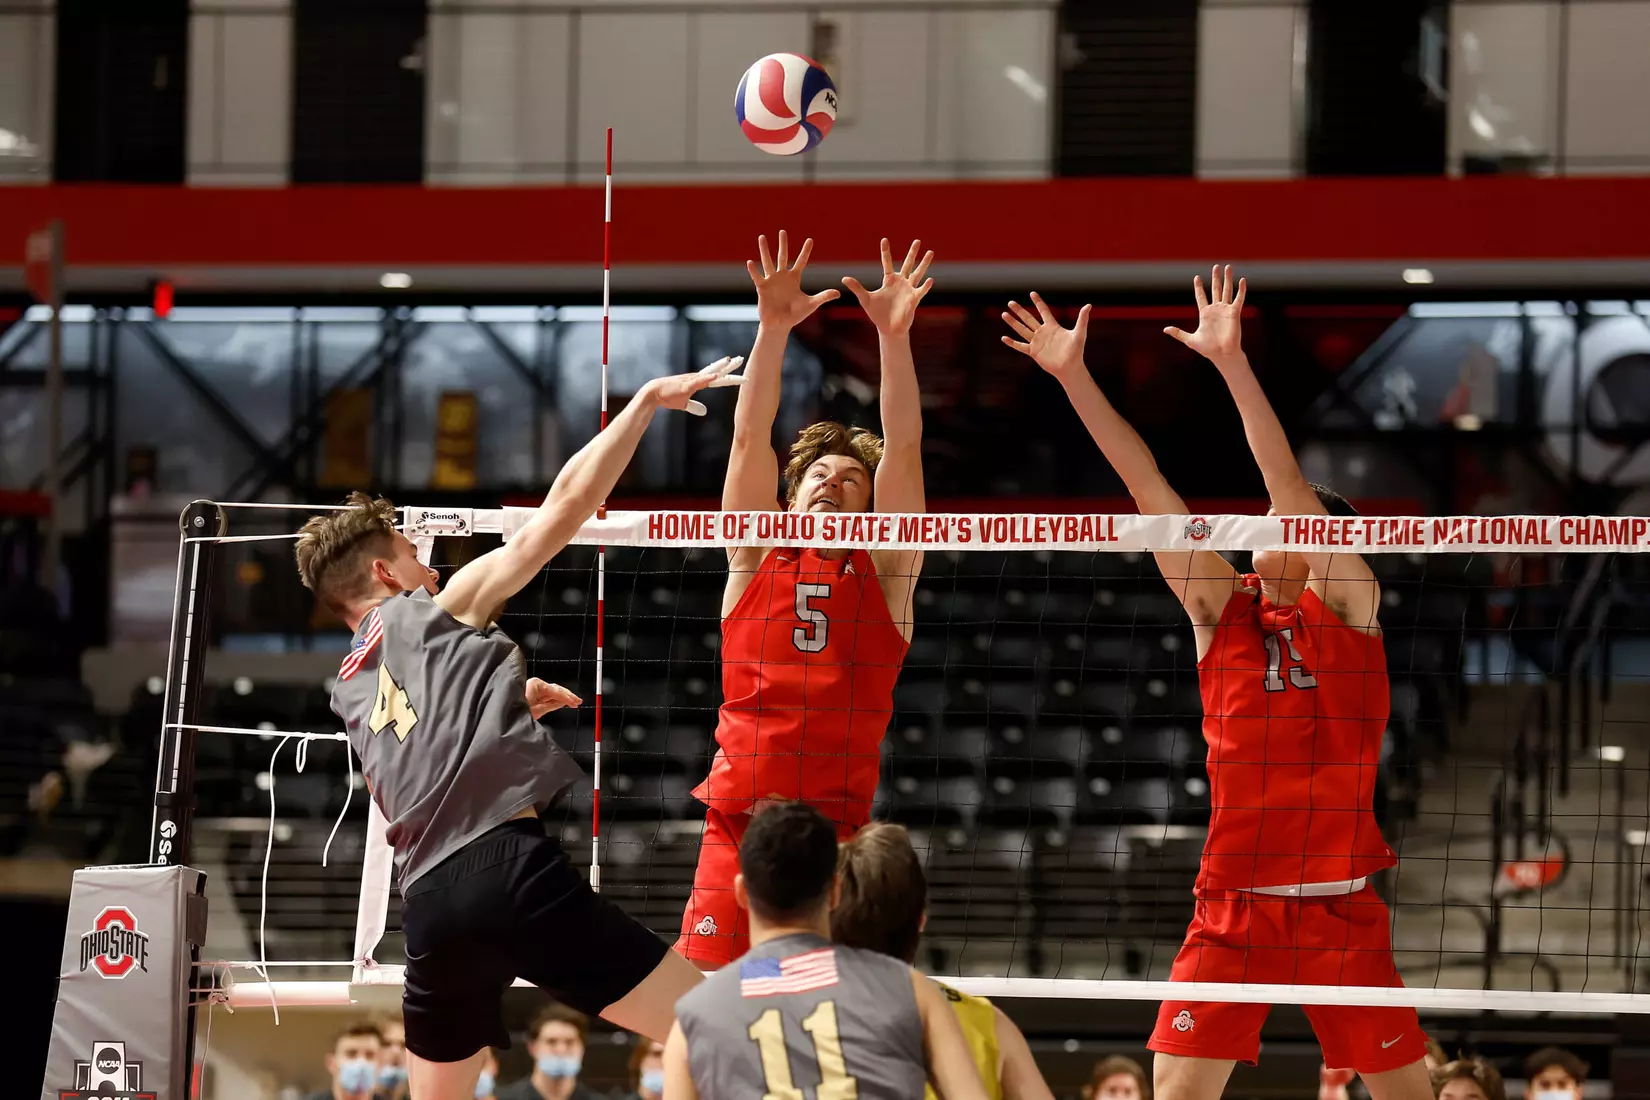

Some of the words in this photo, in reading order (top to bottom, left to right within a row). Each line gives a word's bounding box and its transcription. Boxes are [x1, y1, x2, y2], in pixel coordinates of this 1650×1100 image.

[648, 513, 715, 540] HOME
[722, 513, 750, 540] OF
[756, 513, 815, 540] OHIO
[822, 515, 890, 542] STATE
[897, 516, 972, 543] MEN'S
[978, 515, 1119, 543] VOLLEYBALL
[1280, 517, 1425, 545] THREE-TIME
[1432, 518, 1553, 545] NATIONAL
[792, 582, 831, 653] 5
[1263, 627, 1318, 692] 15
[368, 659, 419, 745] 4
[98, 1060, 121, 1068] NCAA
[747, 999, 858, 1100] 11
